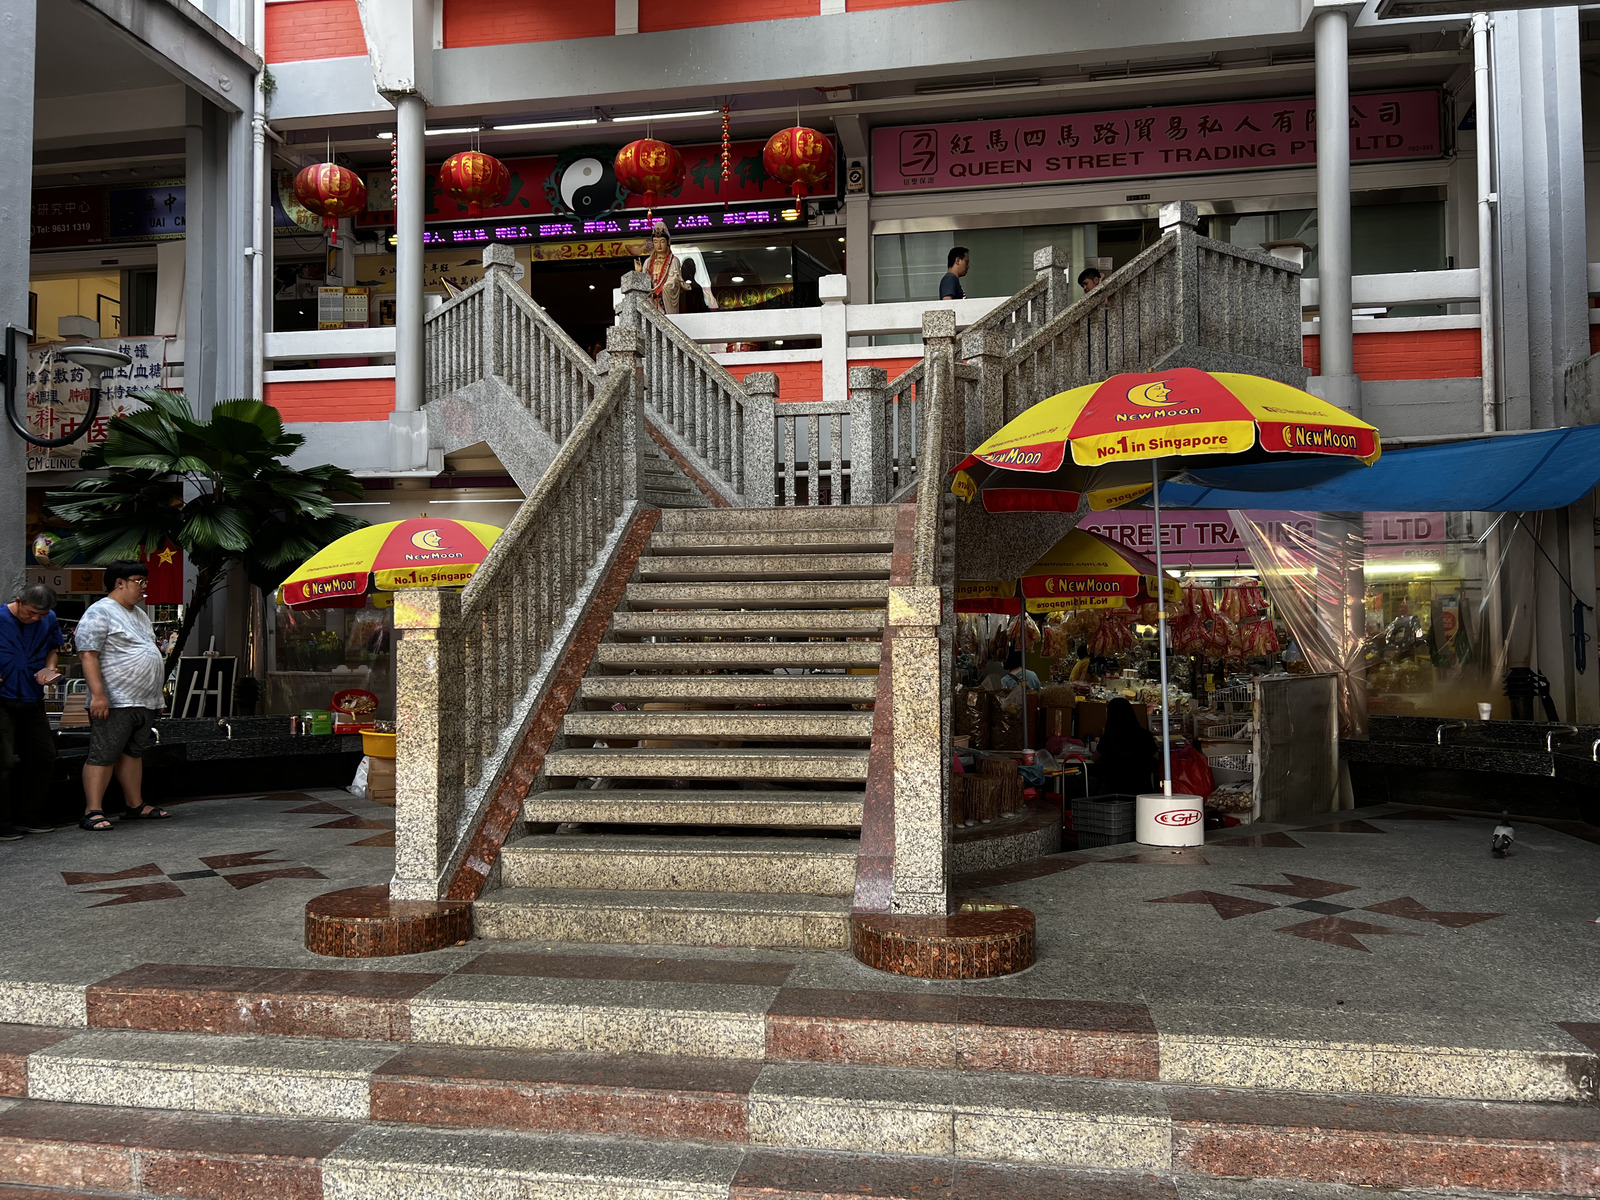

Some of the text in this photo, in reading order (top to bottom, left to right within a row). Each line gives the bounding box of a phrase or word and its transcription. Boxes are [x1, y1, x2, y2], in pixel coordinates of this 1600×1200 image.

[949, 134, 1404, 177] QUEEN STREET TRADING PT LTD
[36, 222, 91, 234] Tel: 9631 1319
[1097, 435, 1228, 458] No.1 in Singapore
[45, 458, 76, 470] CLINIC
[1086, 524, 1187, 545] STREET
[1382, 518, 1432, 540] LTD
[419, 574, 429, 583] in
[431, 572, 472, 583] Singapo
[954, 585, 999, 594] ingapore
